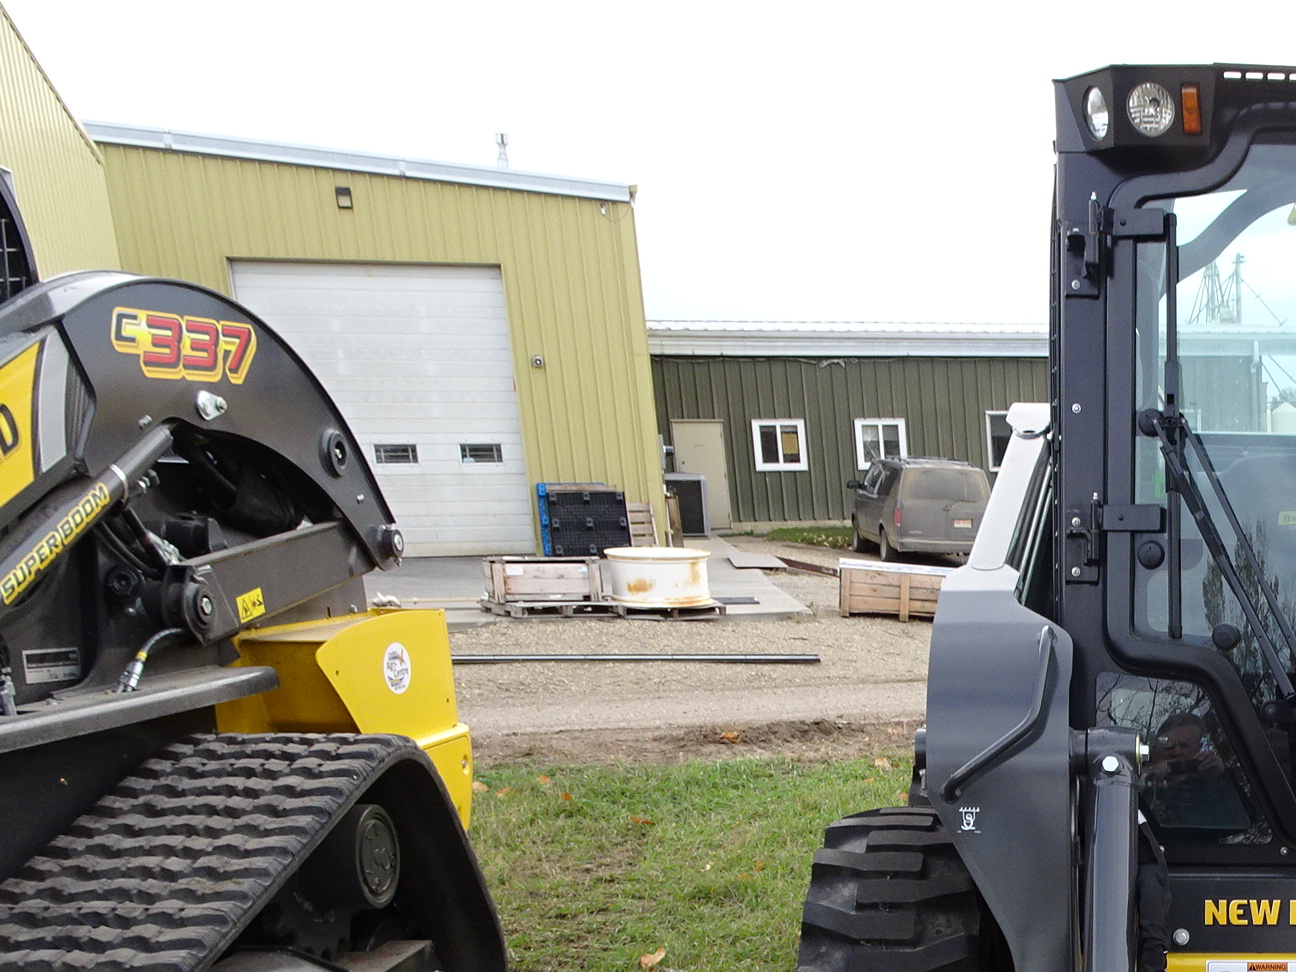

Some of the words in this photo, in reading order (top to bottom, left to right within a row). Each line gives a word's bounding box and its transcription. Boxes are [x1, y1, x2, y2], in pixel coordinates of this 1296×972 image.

[1, 533, 61, 602] SUPER
[59, 484, 108, 542] BOOM
[1204, 899, 1281, 926] NEW
